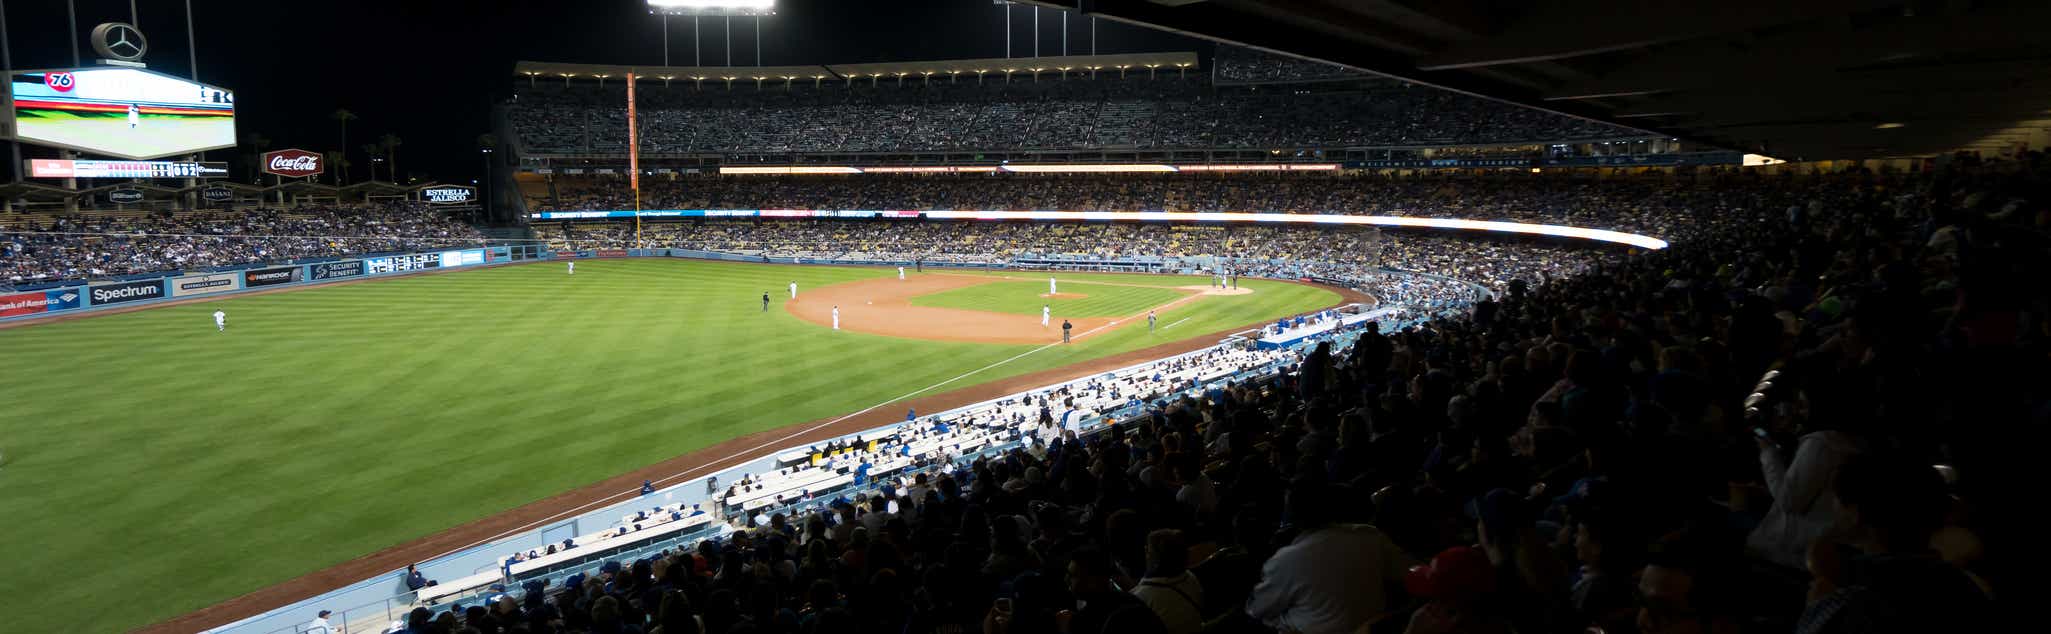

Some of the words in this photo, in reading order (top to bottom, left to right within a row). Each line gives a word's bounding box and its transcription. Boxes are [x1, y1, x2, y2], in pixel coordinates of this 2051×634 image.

[52, 74, 71, 86] 76
[271, 155, 318, 170] Coca-Cola
[329, 262, 360, 270] SECURITY
[330, 269, 358, 277] BENEFIT
[94, 285, 157, 302] Spectrum
[0, 301, 16, 310] ank
[17, 300, 26, 308] of
[26, 298, 60, 307] America
